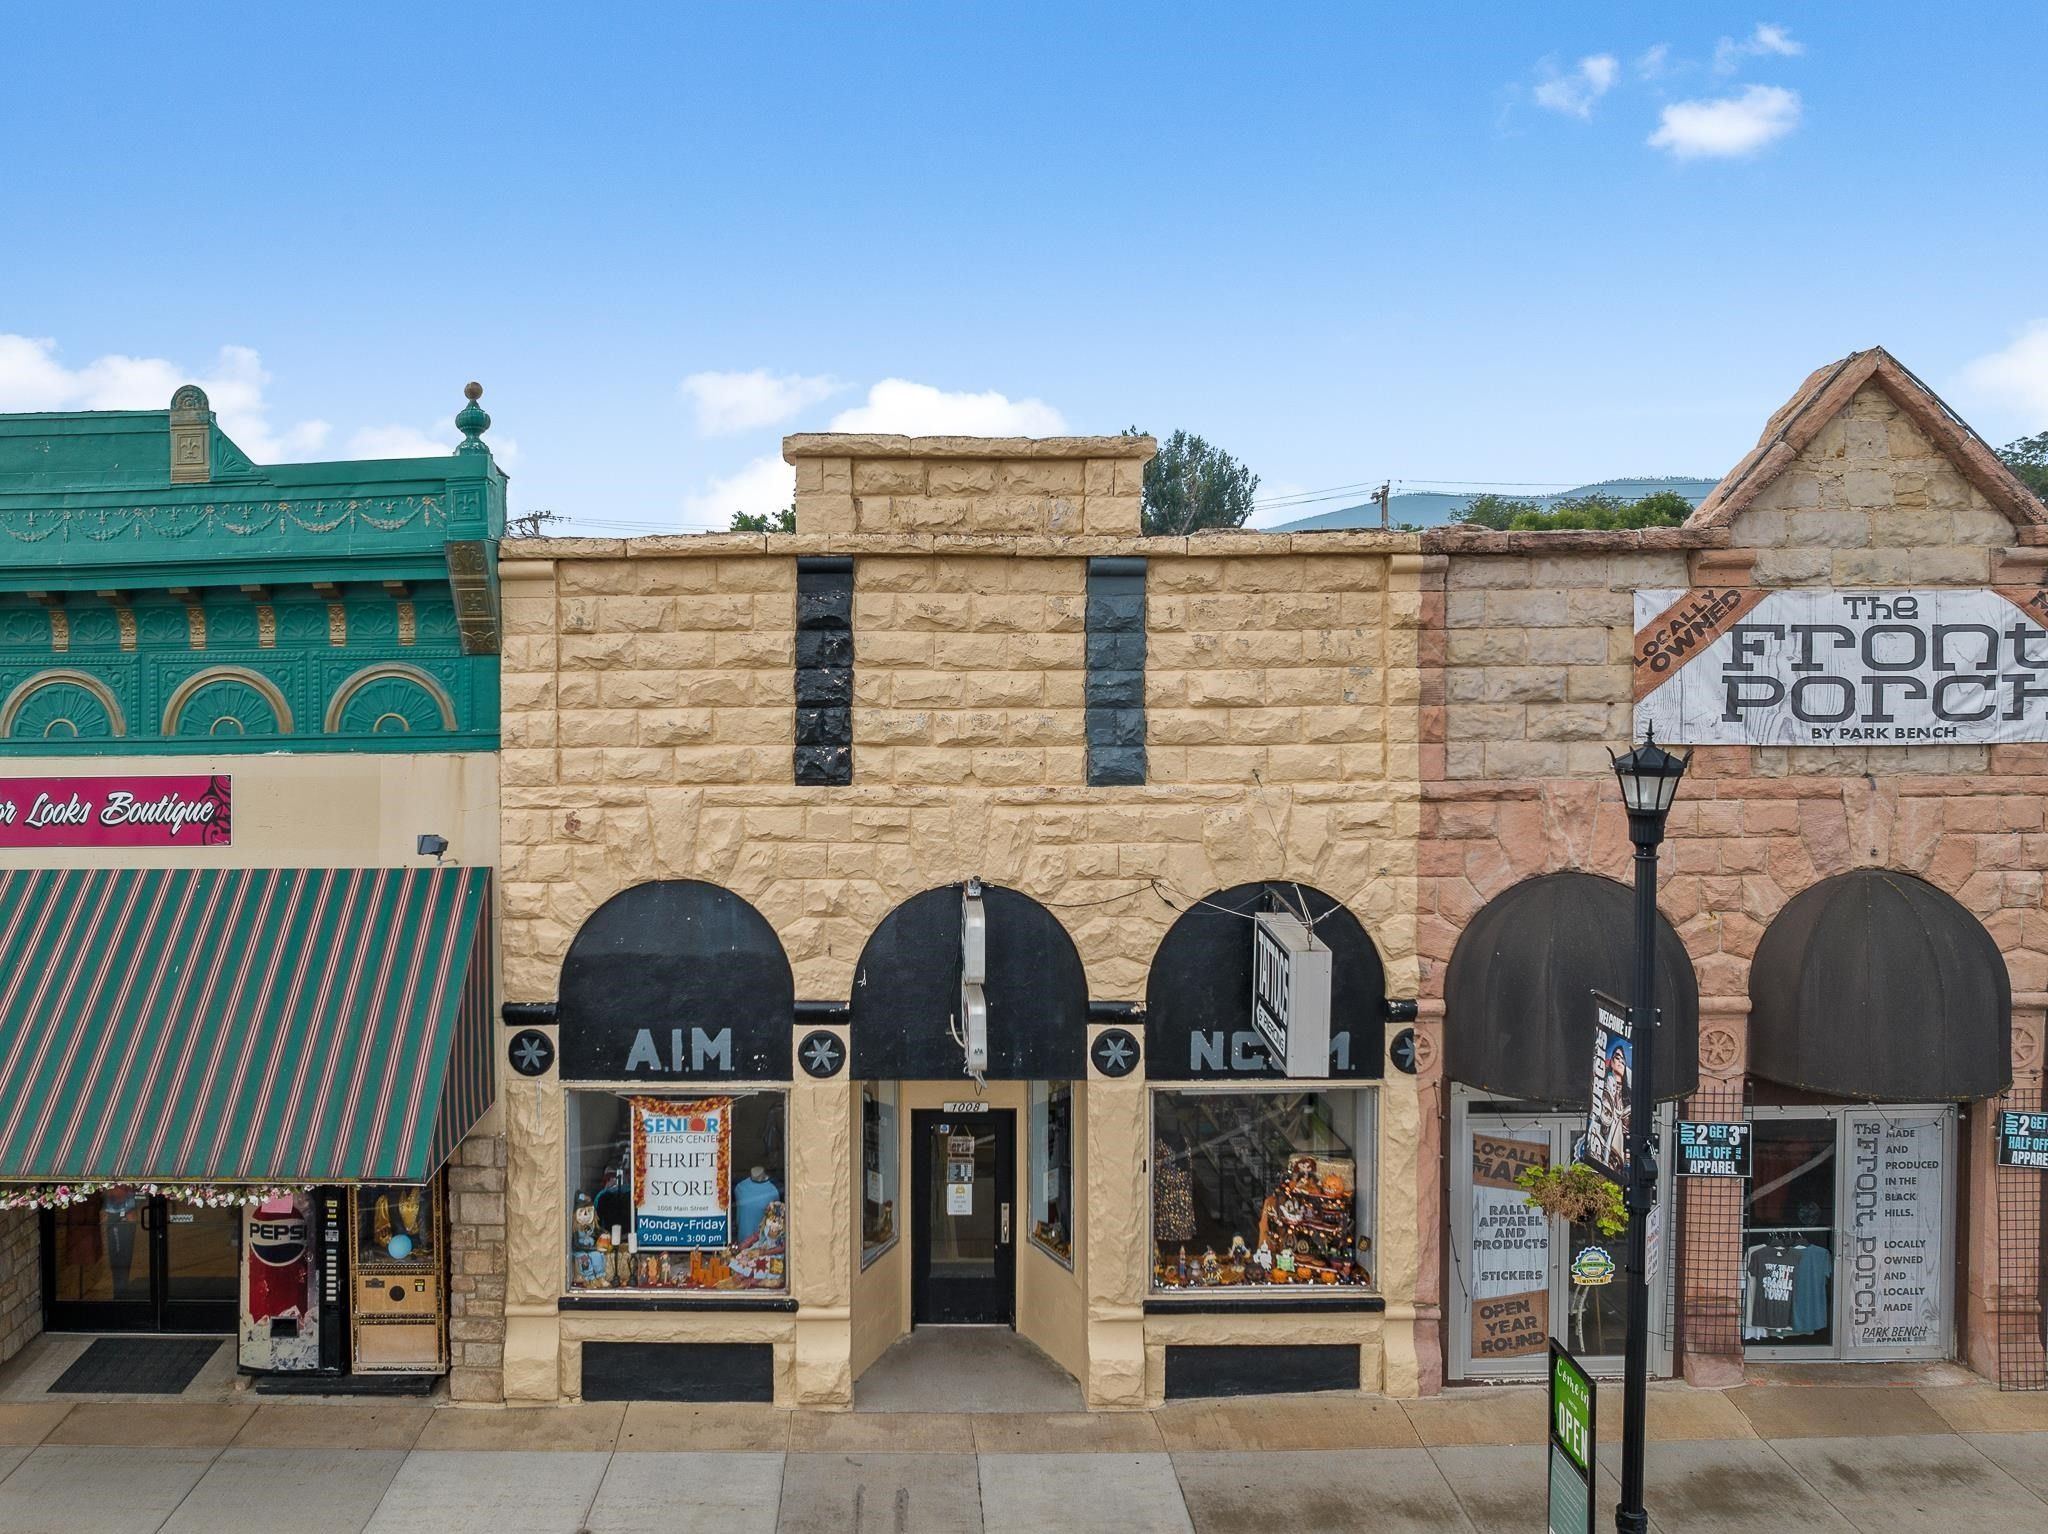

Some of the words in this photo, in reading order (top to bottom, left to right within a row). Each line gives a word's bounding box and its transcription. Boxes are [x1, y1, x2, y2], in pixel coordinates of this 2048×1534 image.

[1633, 590, 1717, 667] LOCALLY
[1650, 590, 1741, 672] OWNED
[1812, 727, 1837, 739] BY
[1840, 727, 1890, 740] PARK
[1895, 726, 1957, 740] BENCH
[24, 792, 92, 827] Looks
[100, 792, 214, 835] Boutique
[1599, 1008, 1625, 1035] WELCOME
[1588, 1030, 1607, 1155] STURGIS
[952, 1103, 980, 1112] 1008
[2005, 1114, 2019, 1135] BUY
[2019, 1115, 2030, 1136] 2
[2031, 1117, 2047, 1129] GET
[645, 1135, 684, 1144] CITIZENS
[1680, 1124, 1696, 1144] BUY
[1696, 1125, 1708, 1145] 2
[1709, 1125, 1728, 1138] GET
[1886, 1130, 1915, 1138] MADE
[2008, 1136, 2032, 1149] HALF
[1685, 1146, 1711, 1159] HALF
[1713, 1146, 1732, 1159] OFF
[1885, 1146, 1908, 1154] AND
[646, 1152, 718, 1168] THRIFT
[1885, 1161, 1939, 1169] PRODUCED
[1690, 1160, 1738, 1174] APPAREL
[1899, 1177, 1916, 1185] THE
[651, 1180, 713, 1197] STORE
[1885, 1193, 1916, 1201] BLACK
[1489, 1205, 1530, 1216] RALLY
[1885, 1209, 1914, 1217] HILLS.
[639, 1218, 726, 1232] Monday-Friday
[1479, 1216, 1542, 1227] APPAREL
[250, 1223, 307, 1240] PEPSI
[1494, 1228, 1527, 1238] AND
[643, 1234, 662, 1242] 9:00
[687, 1234, 705, 1242] 3:00
[708, 1235, 722, 1243] pm
[1473, 1239, 1548, 1250] PRODUCTS
[1884, 1240, 1926, 1248] LOCALLY
[1884, 1256, 1923, 1264] OWNED
[1481, 1270, 1543, 1281] STICKERS
[1883, 1272, 1906, 1280] AND
[1883, 1287, 1925, 1296] LOCALLY
[1479, 1300, 1530, 1320] OPEN
[1486, 1316, 1538, 1336] YEAR
[1862, 1327, 1890, 1338] PARK
[1891, 1326, 1927, 1337] BENCH
[1481, 1331, 1545, 1354] ROUND
[1556, 1360, 1579, 1396] Come
[1558, 1402, 1588, 1466] OPEN
